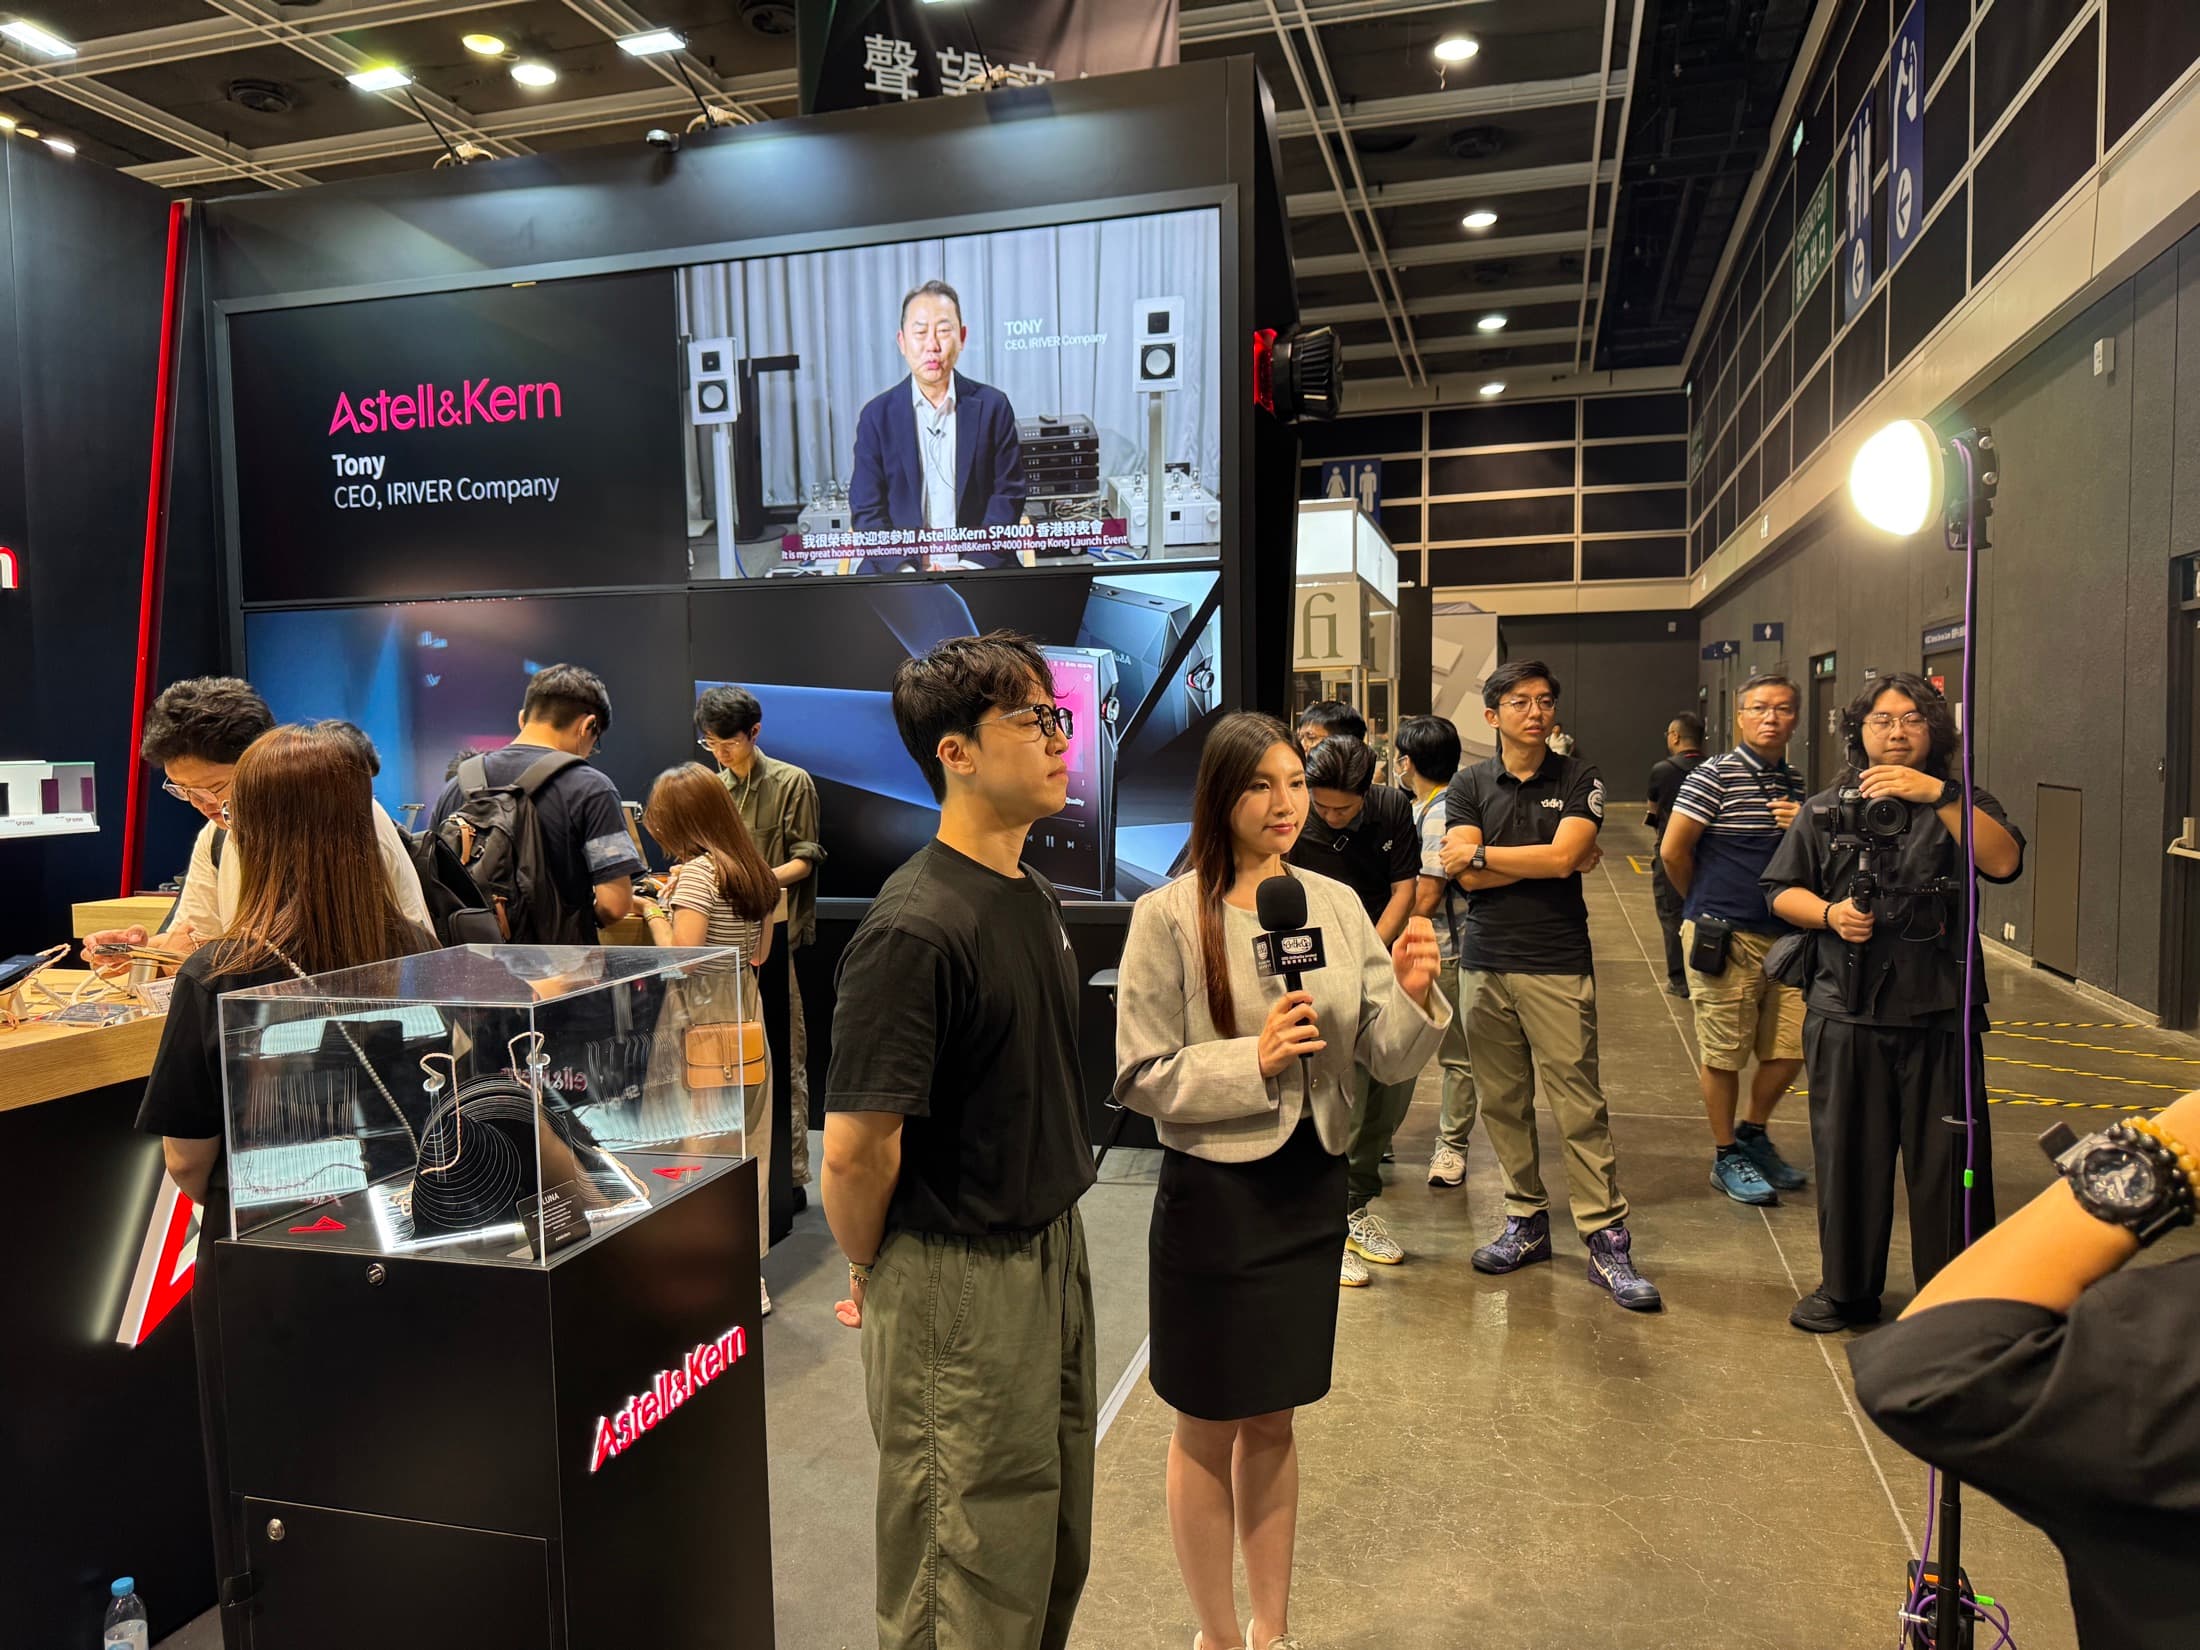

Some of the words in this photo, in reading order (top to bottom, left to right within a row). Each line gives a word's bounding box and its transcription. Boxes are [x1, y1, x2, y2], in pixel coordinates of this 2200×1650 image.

[1004, 319, 1043, 336] TONY
[1029, 335, 1061, 349] IRIVER
[1062, 332, 1108, 346] Company
[329, 378, 562, 436] Astell&Kern
[331, 453, 386, 480] Tony
[334, 484, 383, 511] CEO,
[386, 479, 452, 506] IRIVER
[457, 477, 560, 504] Company
[917, 527, 987, 542] Astell&Kern
[988, 524, 1034, 539] SP4000
[1036, 519, 1104, 538] 香港發表會
[796, 549, 809, 560] my
[809, 547, 831, 560] great
[831, 547, 855, 557] honor
[856, 547, 865, 556] to
[866, 546, 902, 556] welcome
[903, 545, 919, 557] you
[919, 544, 929, 554] to
[930, 543, 944, 553] the
[944, 541, 991, 553] Astell&Kern
[991, 540, 1021, 550] SP4000
[1023, 538, 1047, 550] Hong
[1047, 537, 1070, 549] Kong
[1070, 535, 1101, 547] Launch
[1102, 534, 1128, 545] Event
[590, 1325, 747, 1473] Astell&Kern
